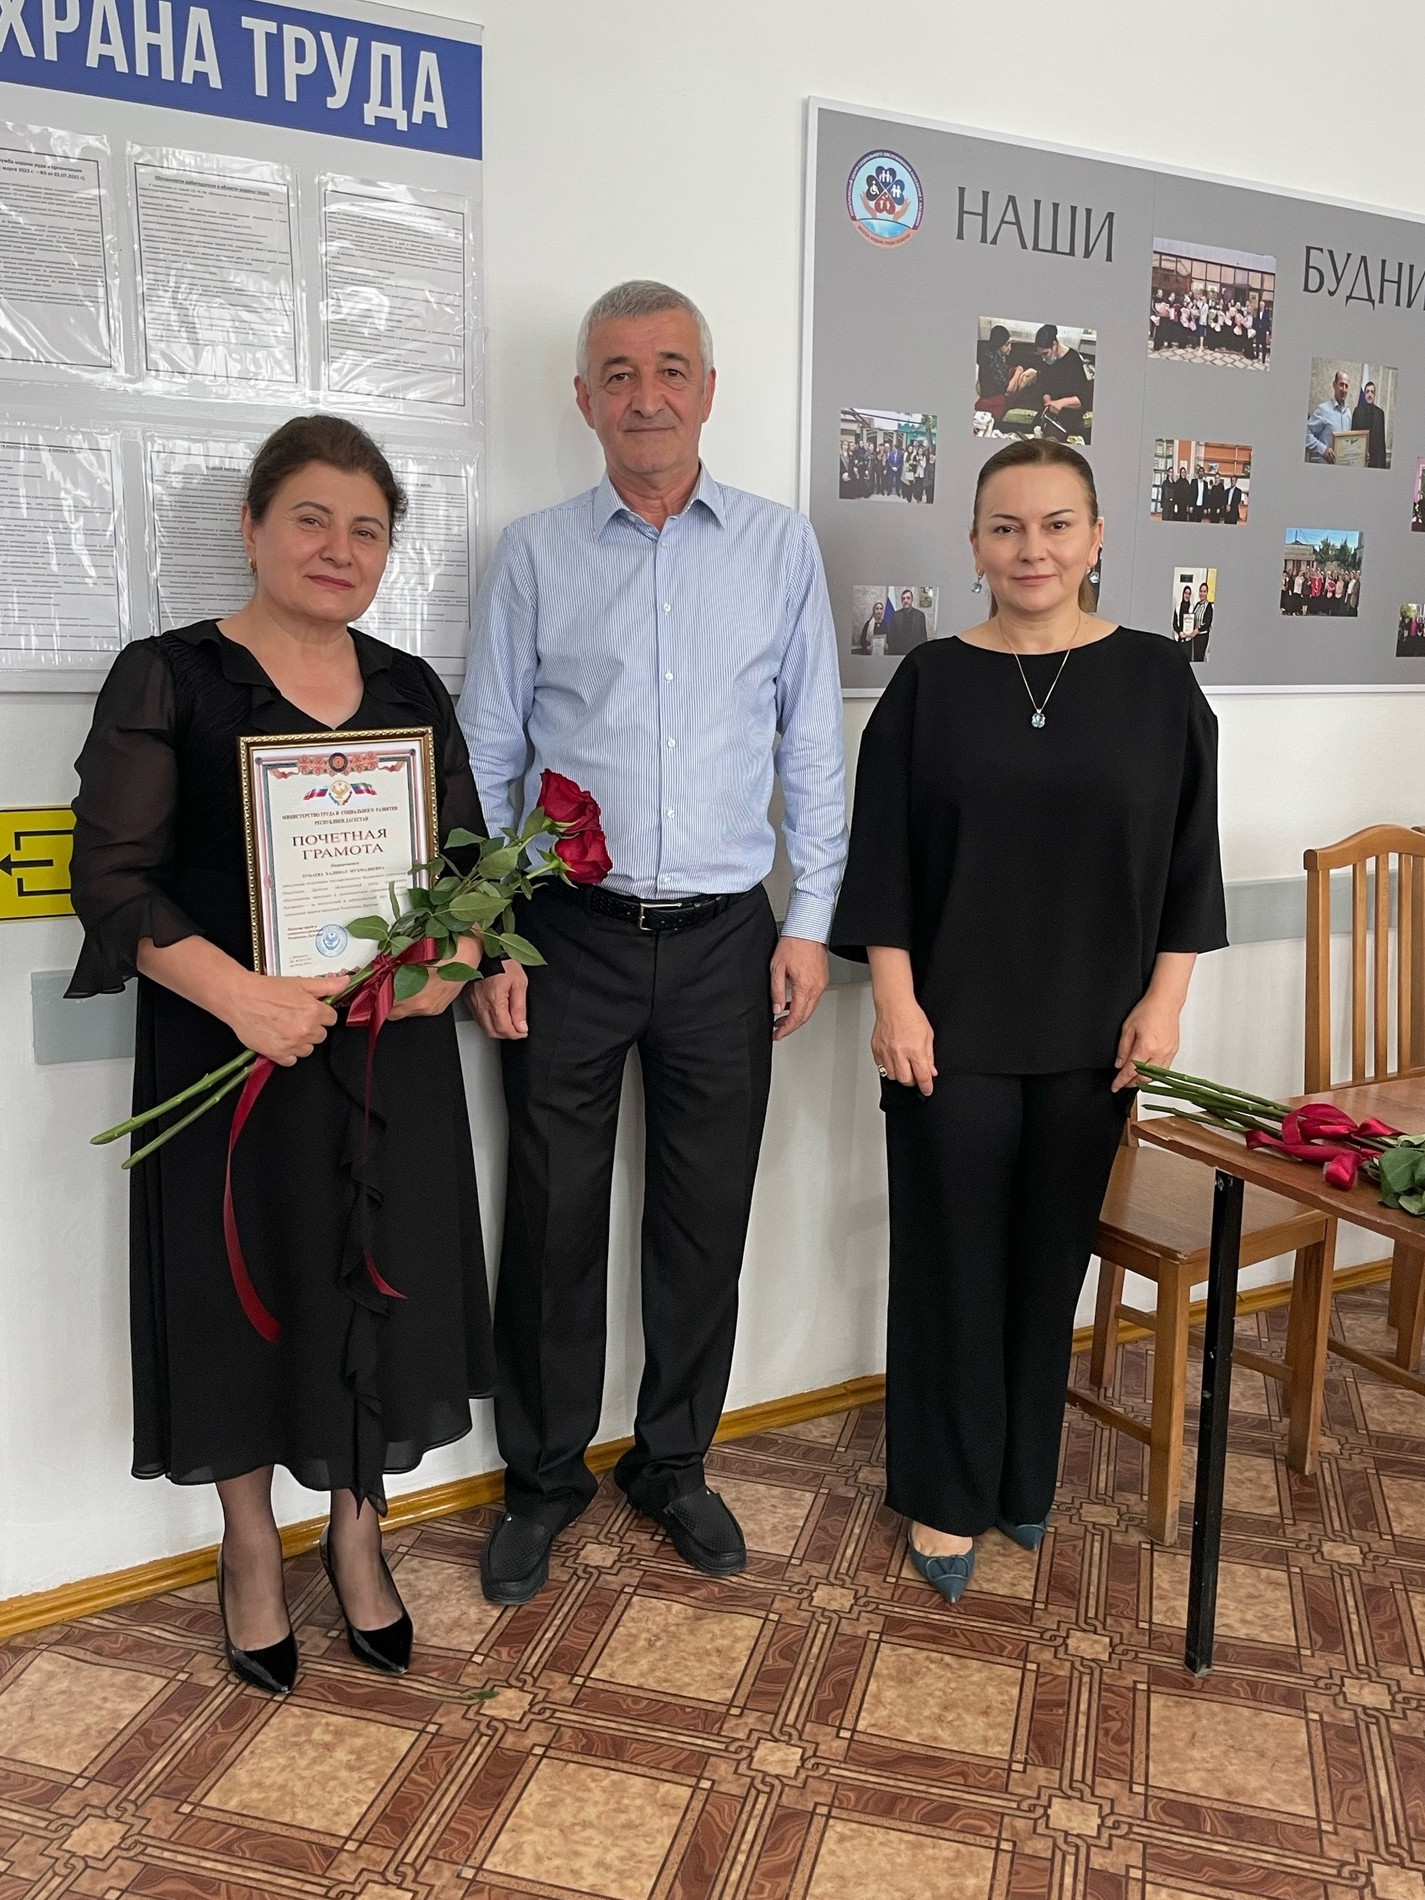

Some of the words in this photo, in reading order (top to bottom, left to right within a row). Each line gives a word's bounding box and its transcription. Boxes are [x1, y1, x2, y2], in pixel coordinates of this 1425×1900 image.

[0, 0, 223, 89] ХРАНА
[241, 16, 448, 131] ТРУДА
[956, 186, 1115, 262] НАШИ
[1302, 245, 1425, 310] БУДНИ
[292, 828, 388, 847] ПОЧЕТНАЯ
[302, 843, 384, 860] ГРАМОТА
